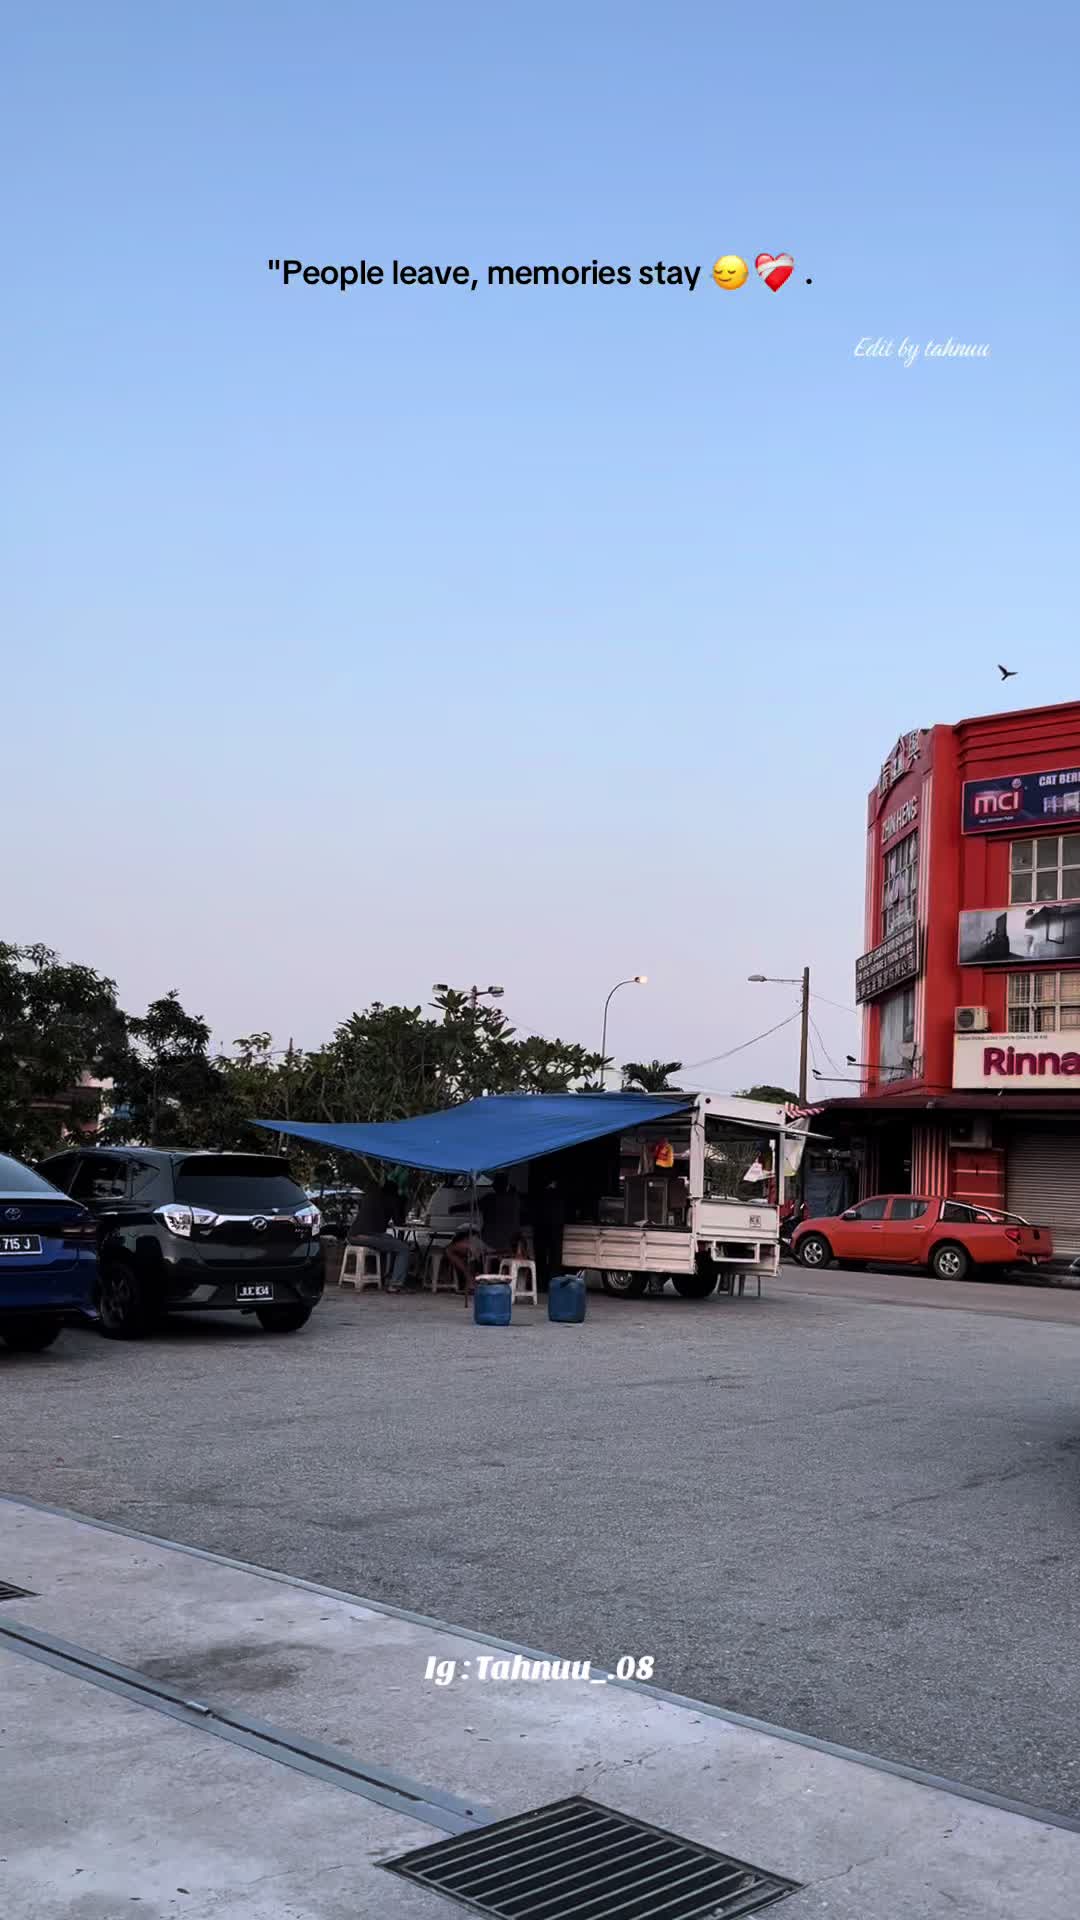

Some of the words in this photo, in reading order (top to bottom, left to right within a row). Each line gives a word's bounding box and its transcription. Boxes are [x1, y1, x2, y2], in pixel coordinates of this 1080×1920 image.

[1039, 774, 1058, 786] CAT
[2, 1238, 21, 1250] 715
[24, 1238, 31, 1250] J
